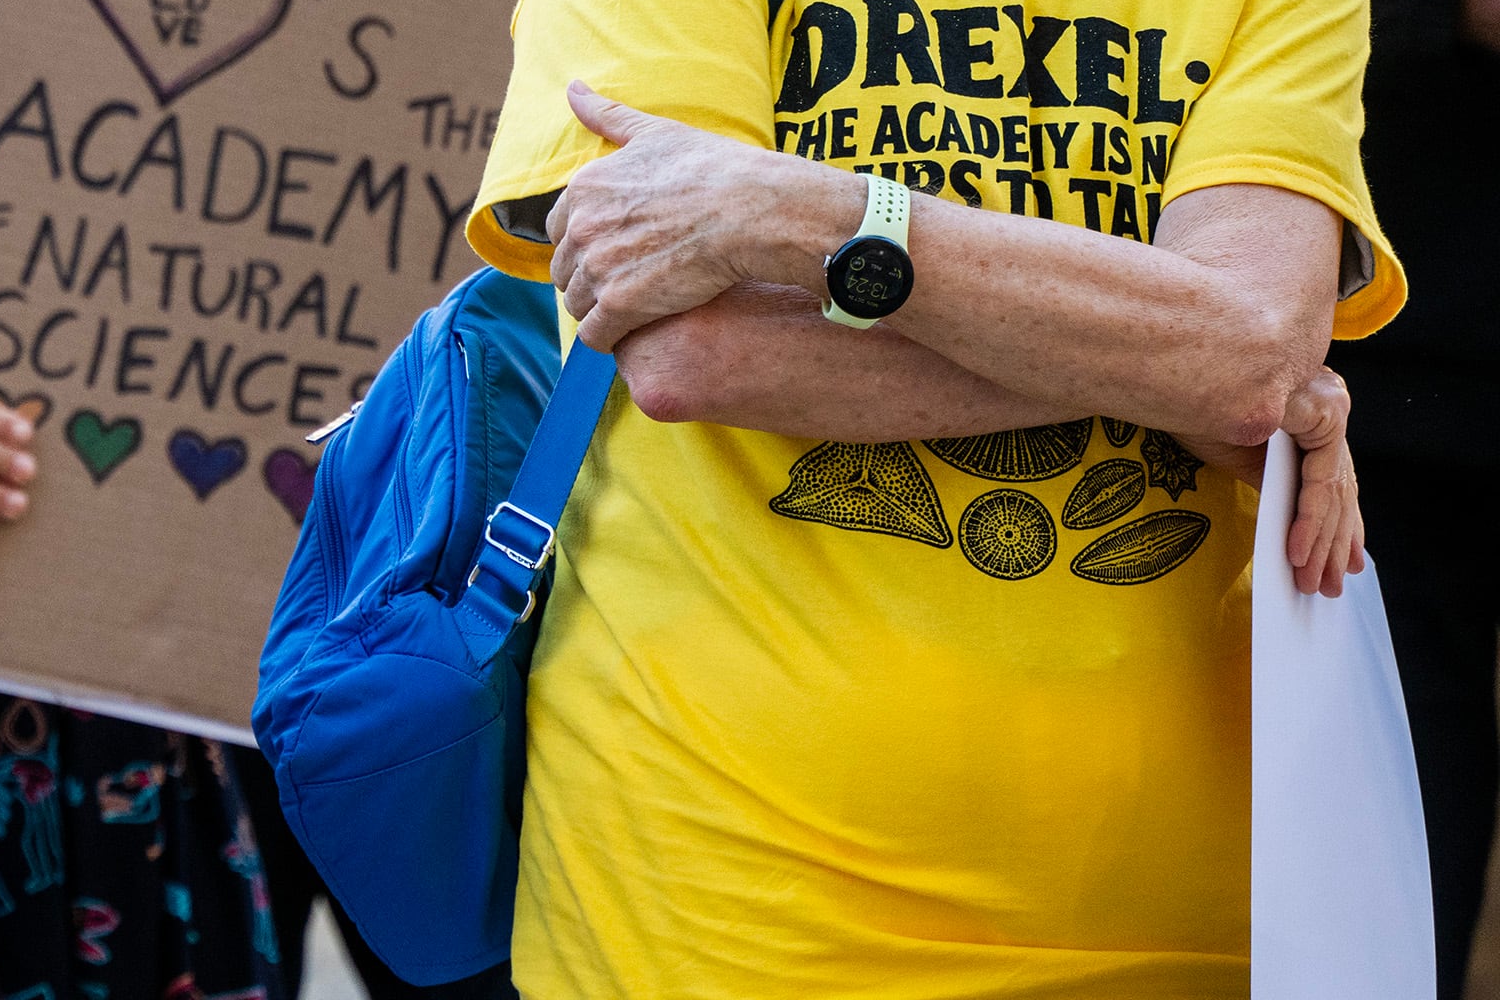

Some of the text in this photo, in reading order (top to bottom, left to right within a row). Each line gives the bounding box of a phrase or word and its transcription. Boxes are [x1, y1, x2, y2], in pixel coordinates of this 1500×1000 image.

[407, 94, 501, 151] THE
[774, 107, 859, 161] THE
[1090, 120, 1133, 175] IS
[20, 213, 380, 349] NATURAL
